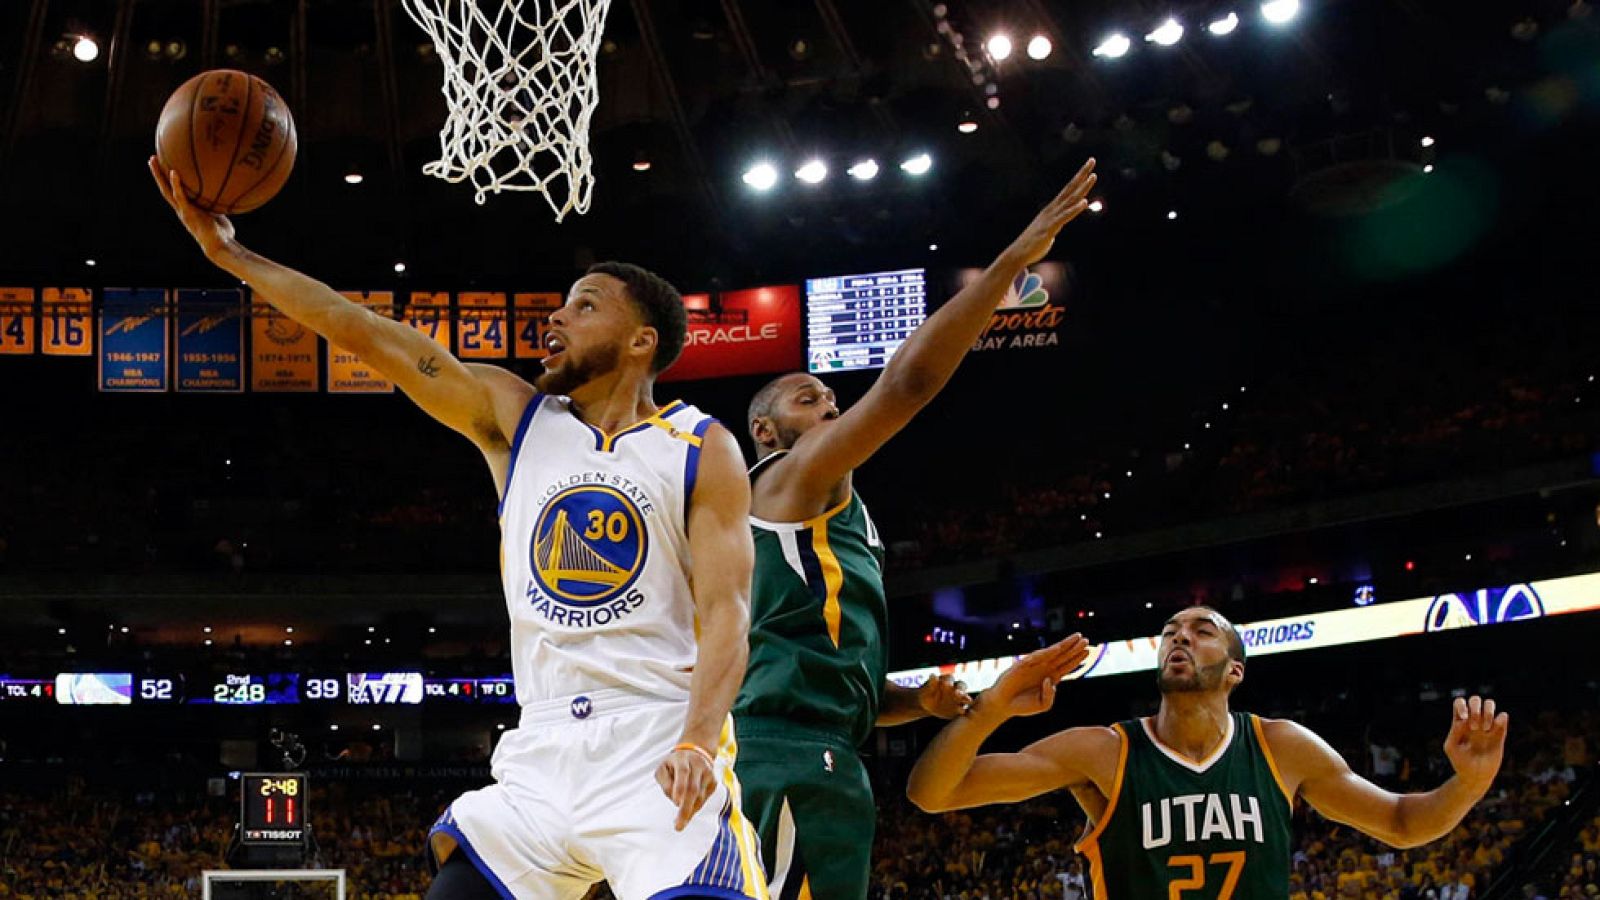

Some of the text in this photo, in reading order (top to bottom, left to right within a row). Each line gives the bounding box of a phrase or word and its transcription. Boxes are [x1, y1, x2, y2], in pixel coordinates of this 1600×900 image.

[0, 312, 24, 345] 4
[51, 312, 84, 346] 16
[983, 303, 1066, 338] ports
[463, 314, 502, 349] 24
[1009, 332, 1059, 349] AREA
[123, 369, 143, 377] NBA
[199, 369, 219, 378] NBA
[106, 379, 160, 387] CHAMPIONS
[182, 379, 236, 388] CHAMPIONS
[335, 380, 388, 388] CHAMPIONS
[537, 472, 654, 516] GOLDEN STATE
[584, 510, 628, 542] 30
[526, 580, 644, 628] WARRIORS
[1243, 621, 1315, 648] RRIORS
[226, 674, 250, 684] 2nd
[31, 684, 41, 697] 4
[141, 680, 172, 698] 52
[214, 684, 265, 702] 2:48
[306, 679, 339, 698] 39
[449, 683, 460, 695] 4
[261, 779, 298, 796] 2:48
[266, 798, 295, 824] 11
[1142, 793, 1264, 850] UTAH
[262, 830, 302, 839] TISSOT
[1167, 850, 1247, 900] 27
